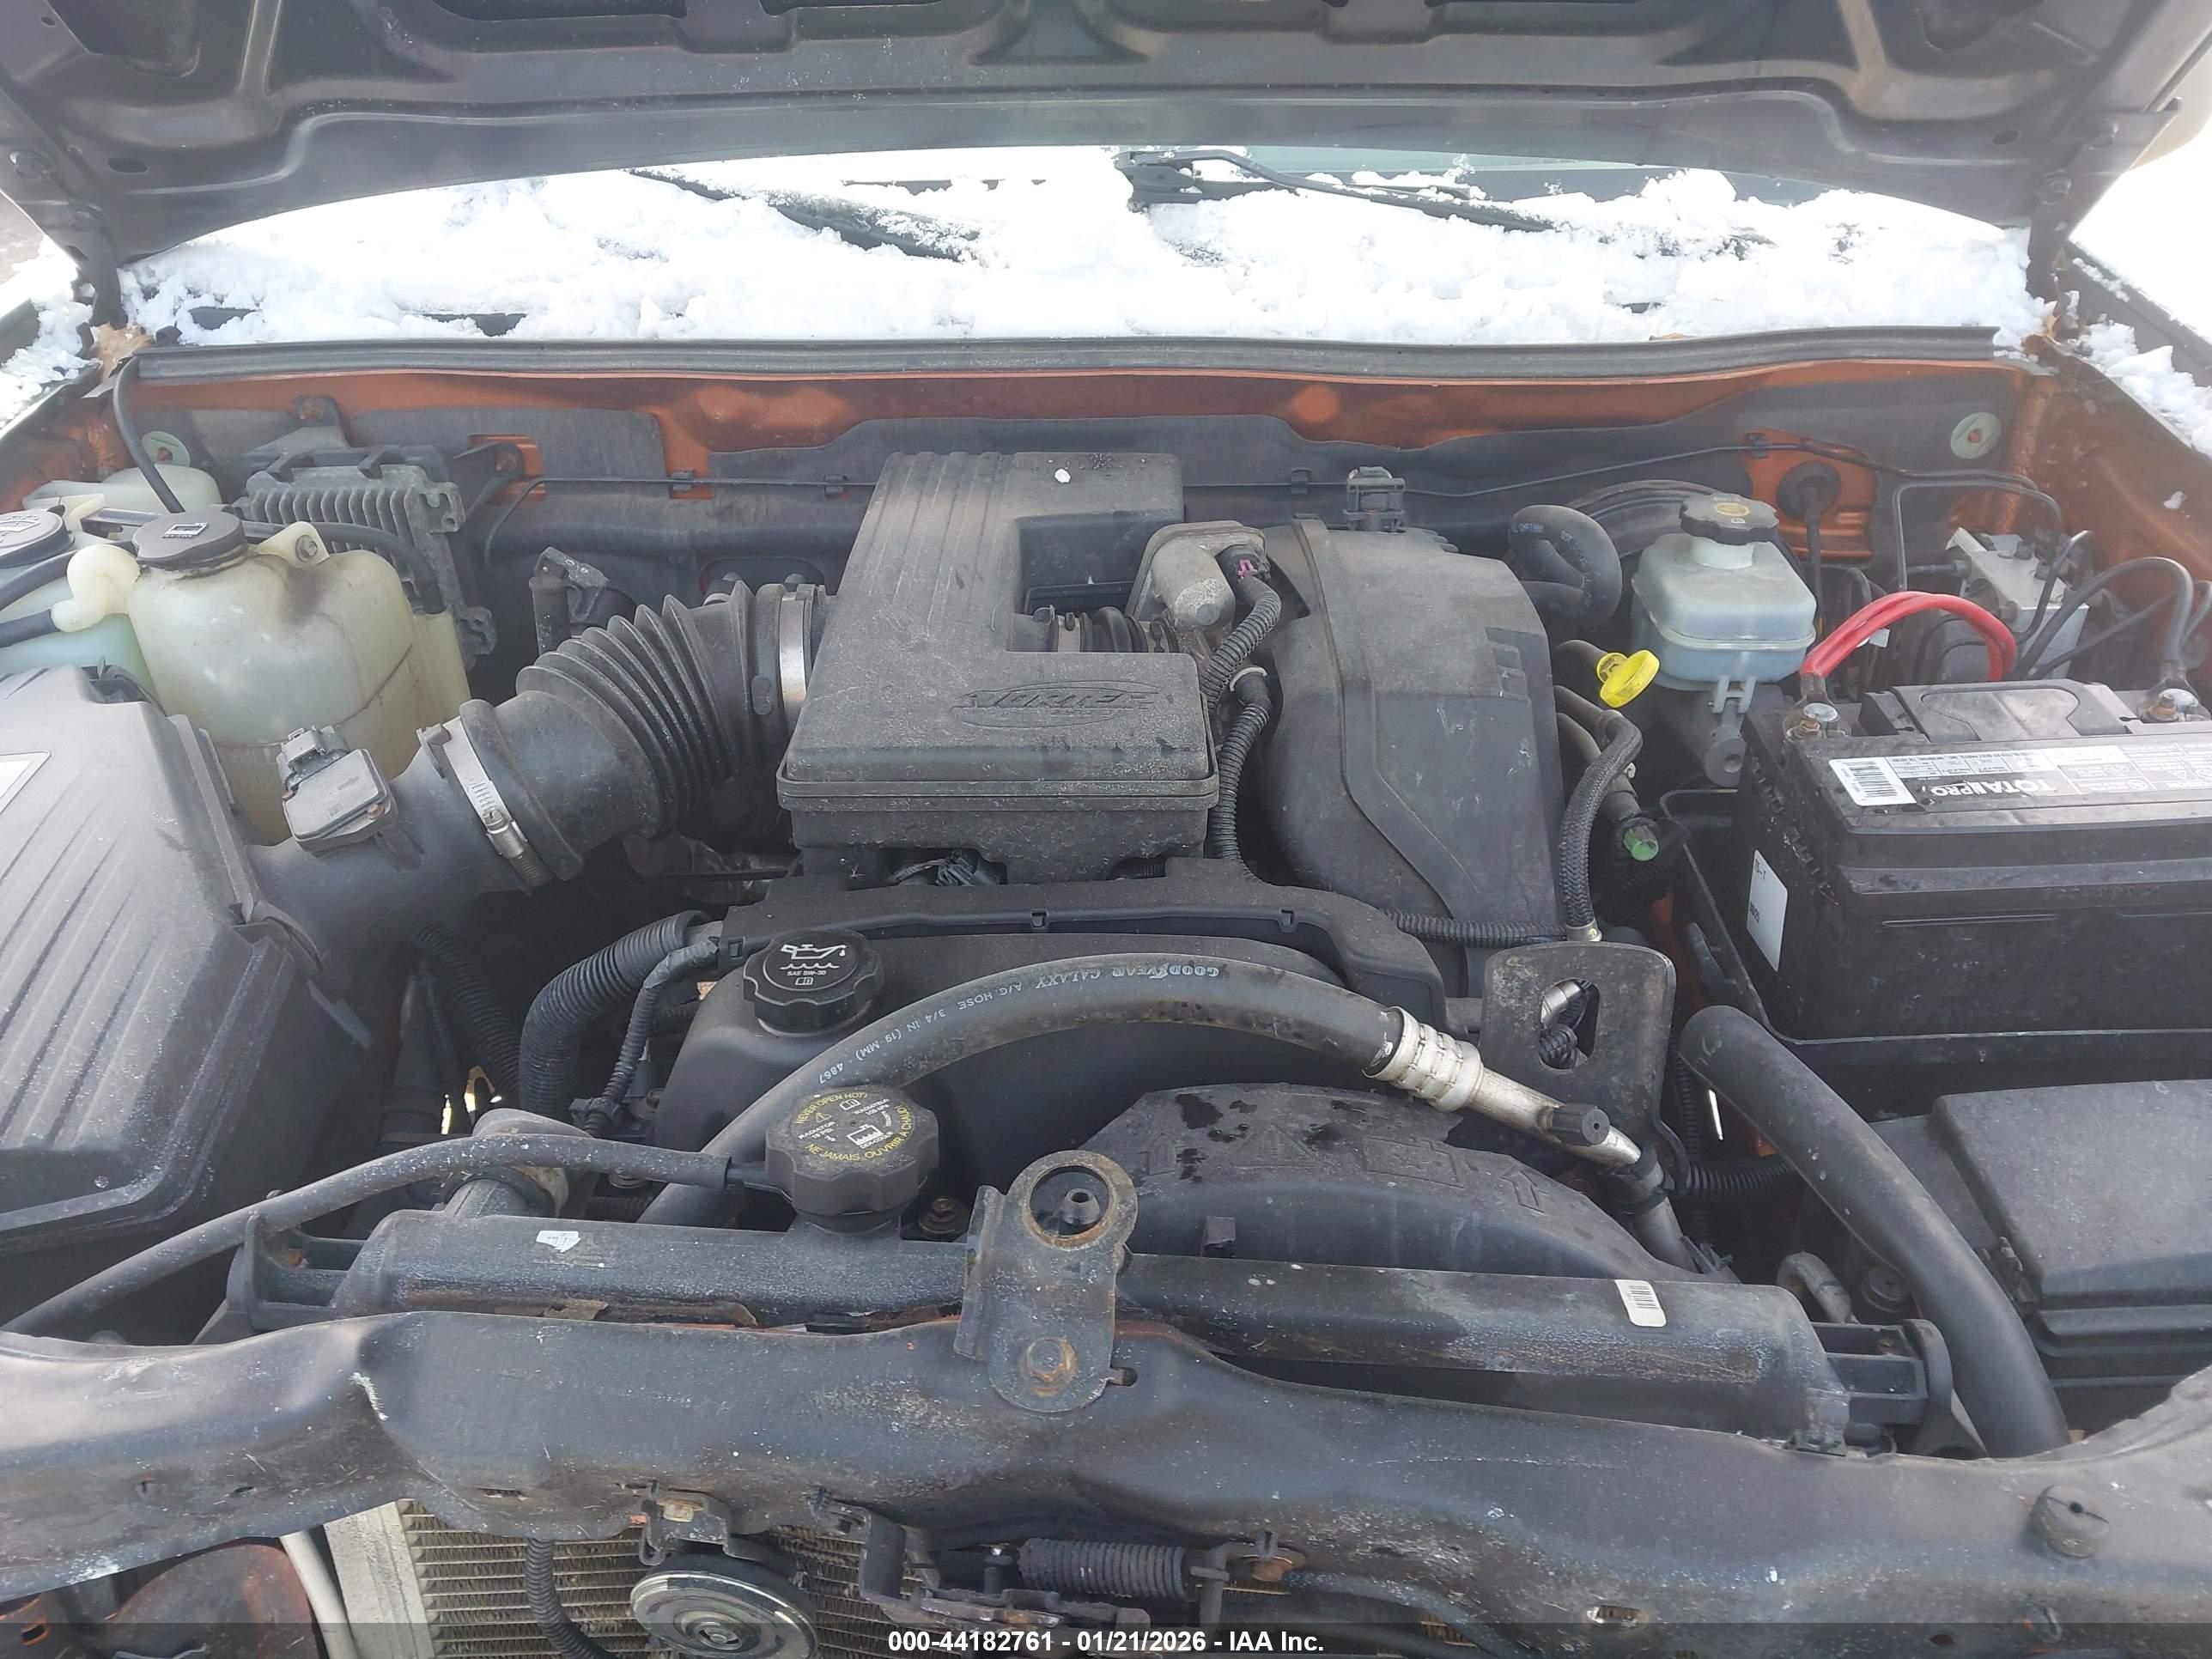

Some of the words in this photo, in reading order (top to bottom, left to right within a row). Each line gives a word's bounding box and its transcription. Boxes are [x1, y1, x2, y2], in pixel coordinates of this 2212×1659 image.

[1034, 968, 1102, 989] GALAXY
[1112, 963, 1220, 979] GOODYEAR
[957, 991, 993, 1010] HOSE
[906, 1019, 921, 1032] IN
[925, 1008, 946, 1023] 3/4
[885, 1028, 902, 1043] (19
[855, 1040, 881, 1061] MM)
[818, 1061, 844, 1085] 4867
[794, 1104, 817, 1125] NEVER
[816, 1094, 844, 1108] OPEN
[805, 1142, 822, 1155] NE
[820, 1150, 860, 1161] JAMAIS
[864, 1136, 904, 1159] OUVRIR
